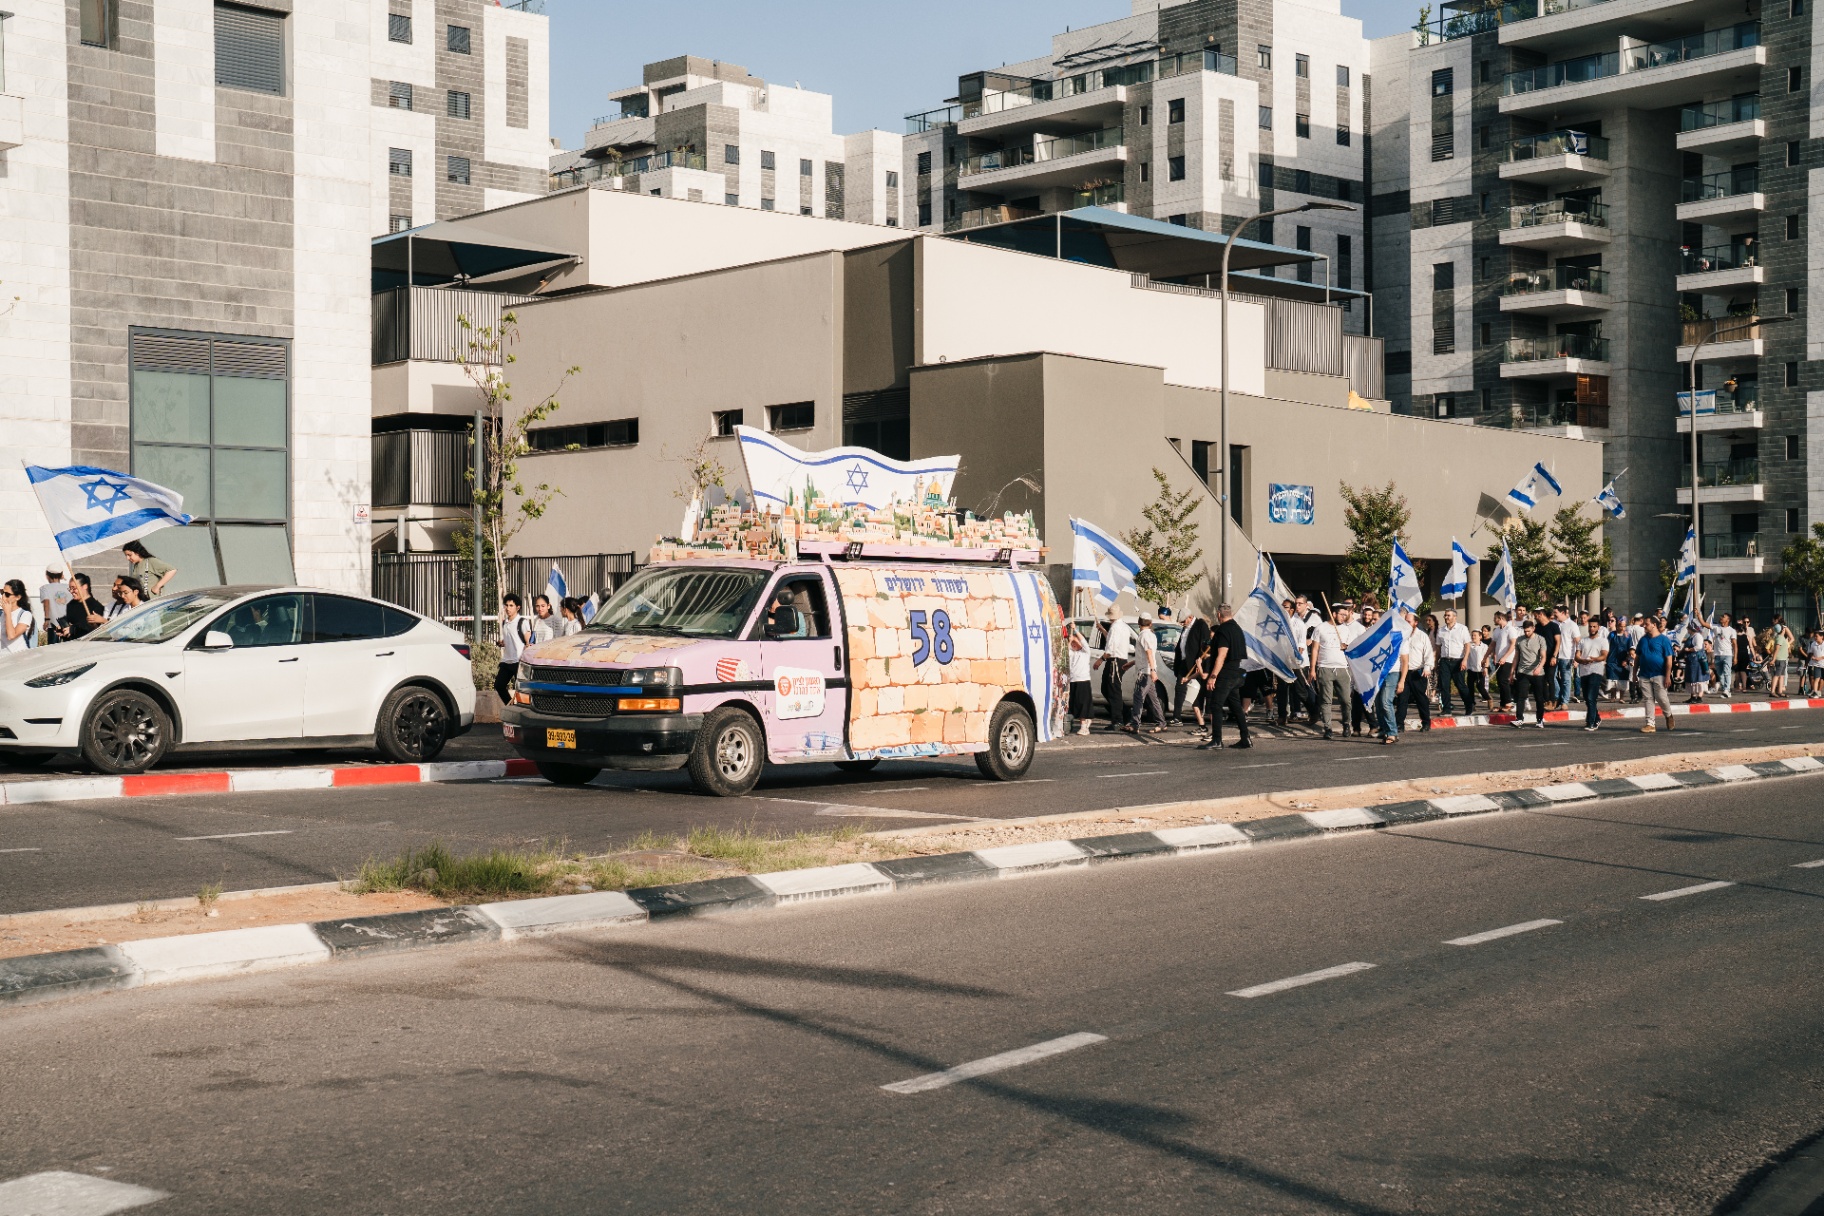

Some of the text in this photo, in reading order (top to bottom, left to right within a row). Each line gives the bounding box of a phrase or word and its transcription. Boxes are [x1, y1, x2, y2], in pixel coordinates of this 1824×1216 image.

[884, 574, 969, 594] לשחרור ירושלים
[909, 608, 955, 668] 58
